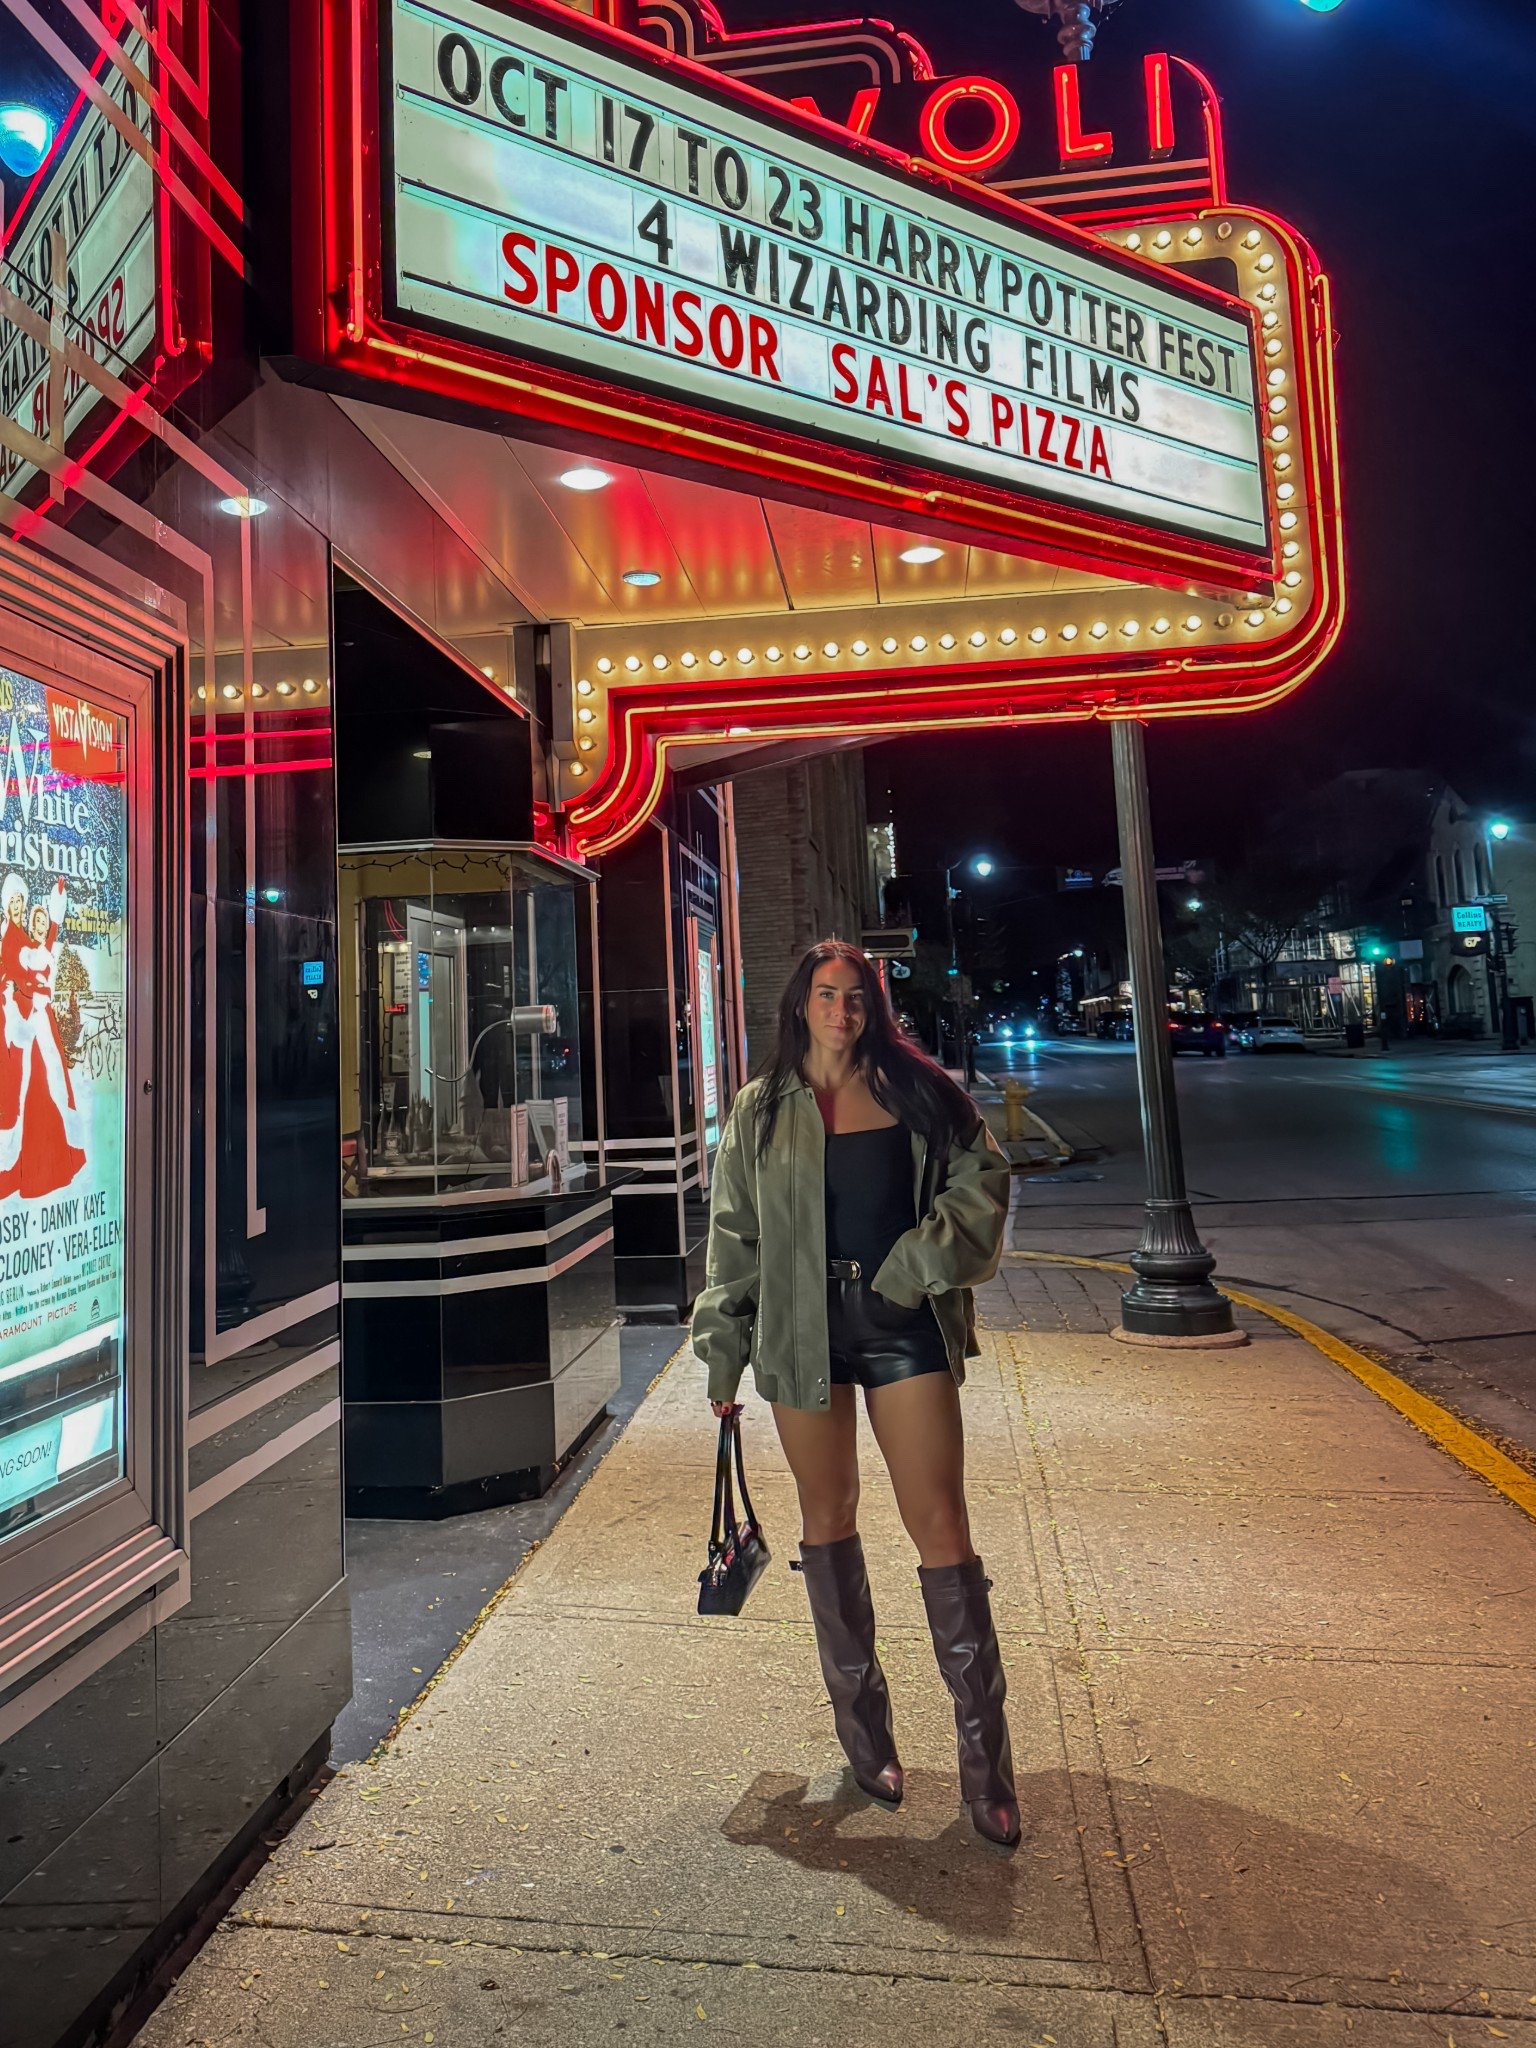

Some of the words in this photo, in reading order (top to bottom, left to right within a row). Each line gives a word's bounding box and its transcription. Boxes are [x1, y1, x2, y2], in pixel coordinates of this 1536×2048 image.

[437, 32, 568, 140] OCT
[602, 97, 655, 172] 17
[677, 127, 749, 210] TO
[768, 166, 823, 241] 23
[844, 196, 992, 306] HARRY
[1001, 263, 1148, 365] POTTER
[1158, 323, 1236, 393] FEST
[637, 199, 674, 265] 4
[720, 223, 992, 374] WIZARDING
[1025, 338, 1141, 423] FILMS
[501, 231, 782, 382] SPONSOR
[831, 343, 972, 440] SAL'S
[991, 393, 1114, 480] PIZZA
[0, 1211, 29, 1245] SBY
[41, 1198, 79, 1234] DANNY
[83, 1190, 106, 1222] KAYE
[63, 1219, 121, 1262] VERA-ELLEN
[47, 1301, 78, 1322] PICTURE
[16, 1440, 53, 1472] SOON!
